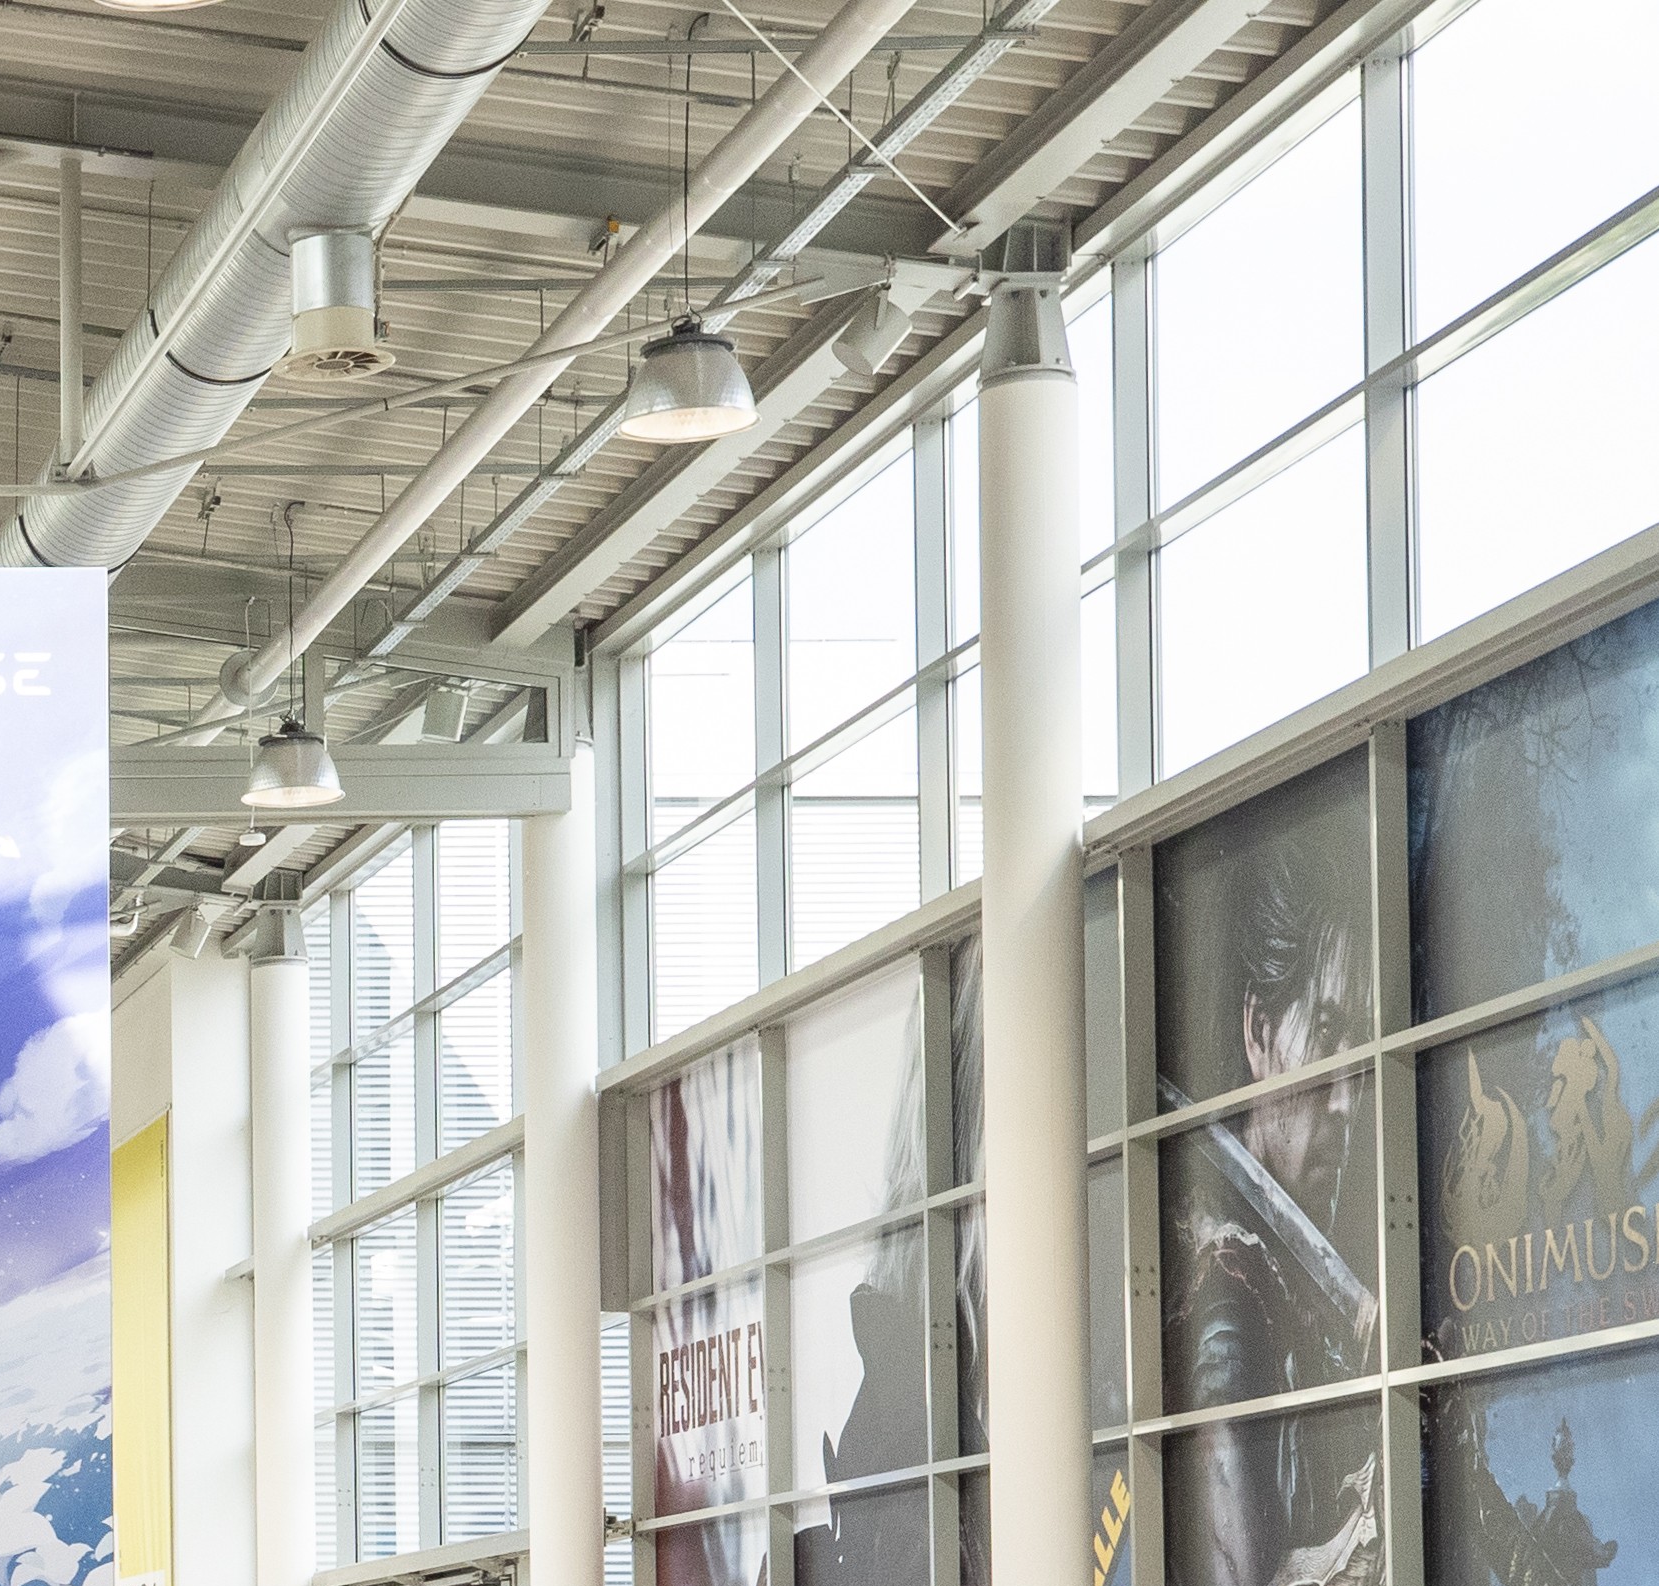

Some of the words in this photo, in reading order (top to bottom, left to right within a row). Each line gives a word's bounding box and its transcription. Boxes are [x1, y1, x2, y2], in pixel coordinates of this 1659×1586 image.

[1449, 1203, 1659, 1311] ONIMUS
[1462, 1316, 1512, 1351] WAY
[1522, 1309, 1550, 1342] OF
[1565, 1297, 1610, 1332] THE
[659, 1328, 741, 1438] RESIDENT
